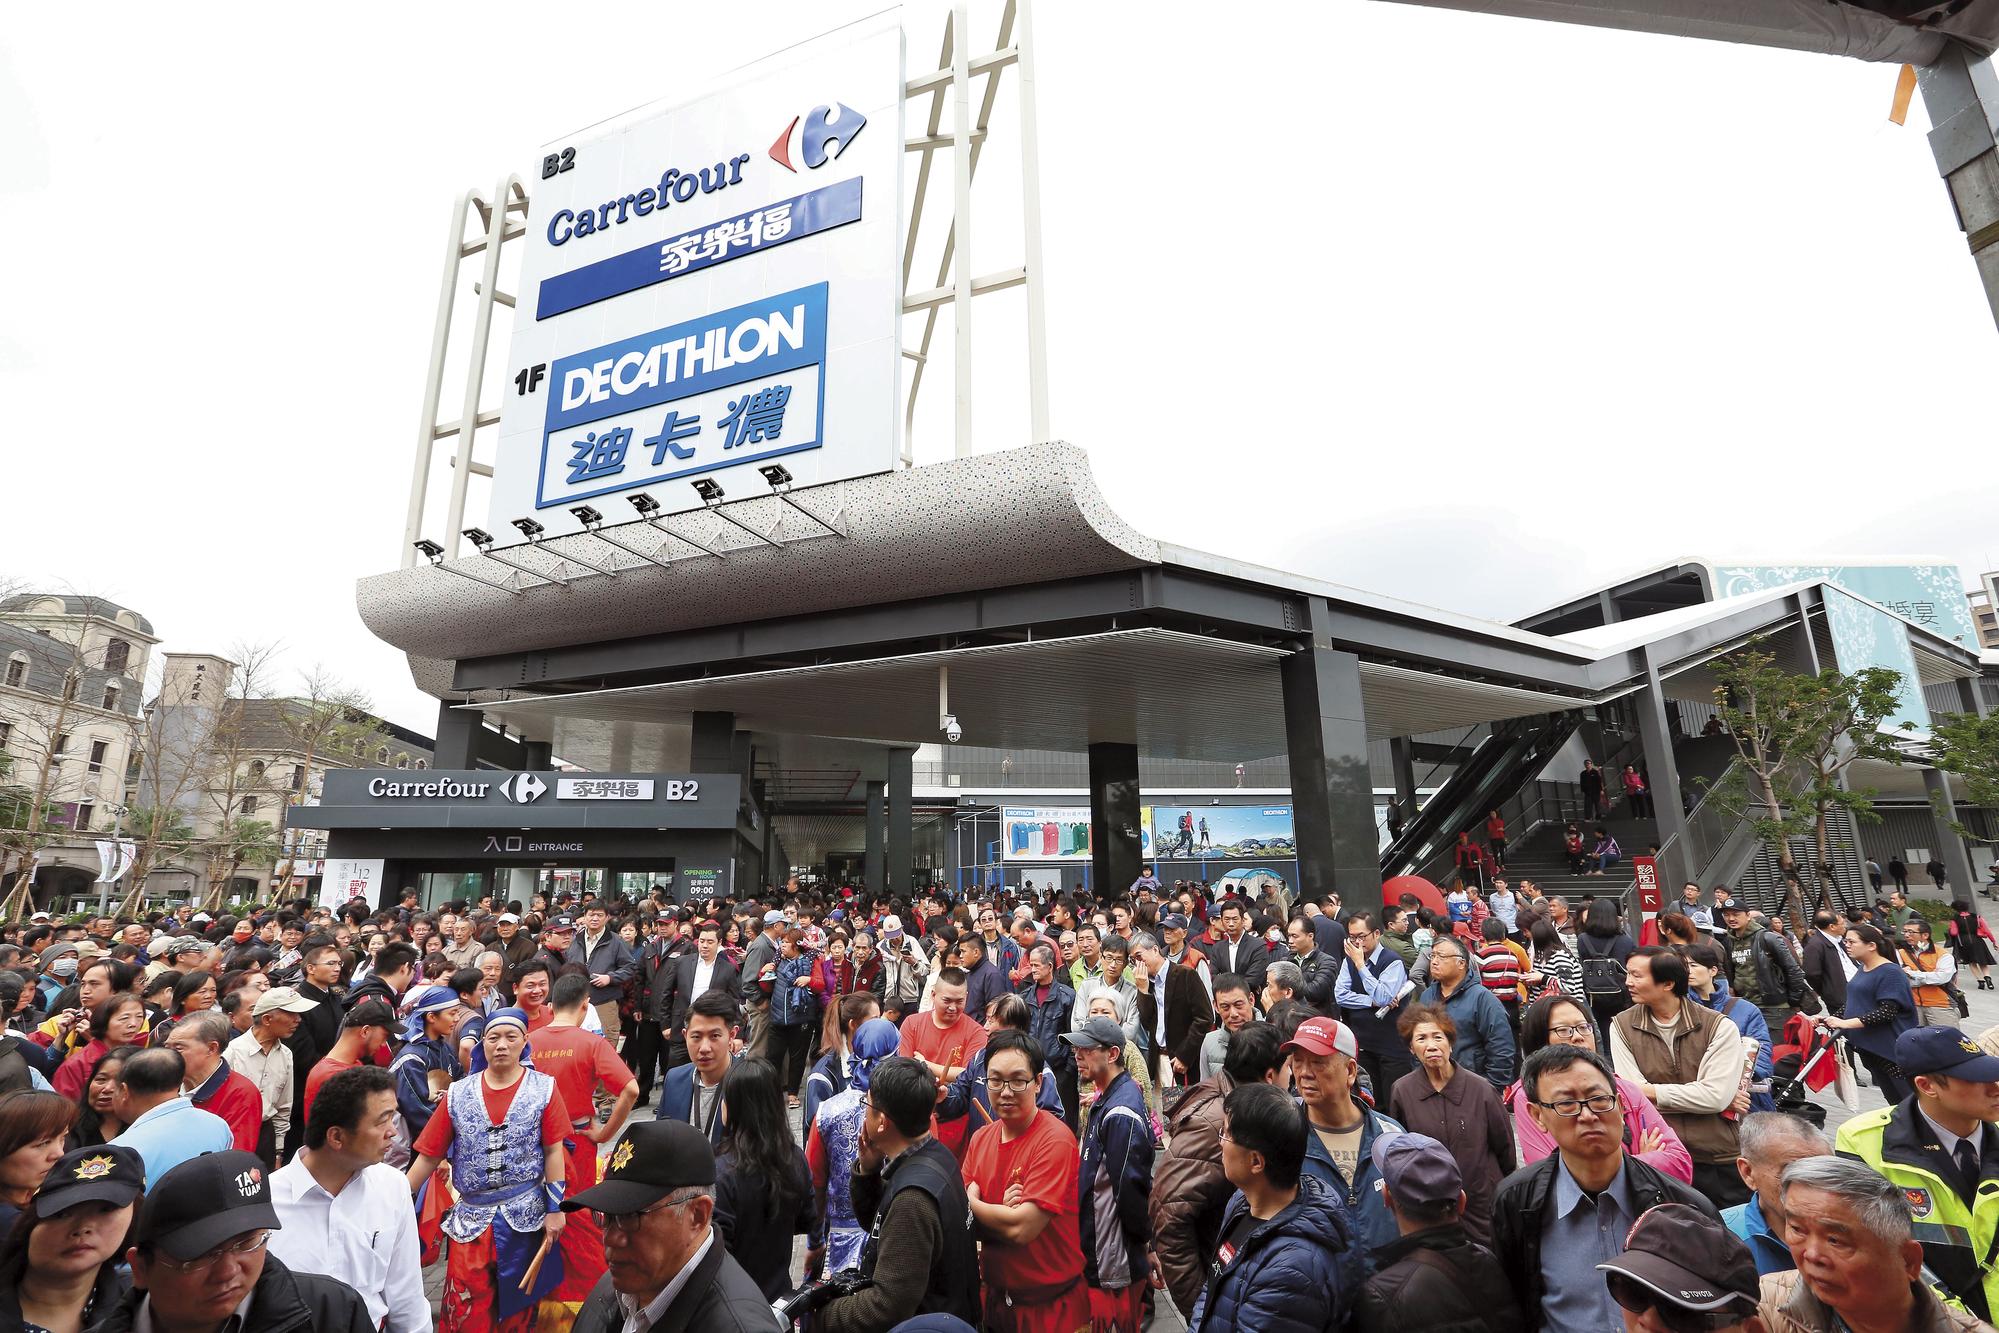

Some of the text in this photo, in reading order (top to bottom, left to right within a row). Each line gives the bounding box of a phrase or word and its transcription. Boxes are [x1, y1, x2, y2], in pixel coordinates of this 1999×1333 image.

[542, 146, 576, 180] B2
[546, 152, 749, 246] Carrefour
[659, 202, 793, 273] 家樂福
[561, 304, 805, 412] DECATHLON
[514, 363, 546, 396] 1F
[566, 384, 792, 485] 迪卡儂
[368, 777, 699, 801] Carrefour 家樂福 B2
[483, 836, 583, 853] 入口 ENTRANCE
[690, 886, 714, 895] 09:00
[238, 1182, 261, 1197] YUAN
[1688, 1290, 1714, 1298] TOYOTA
